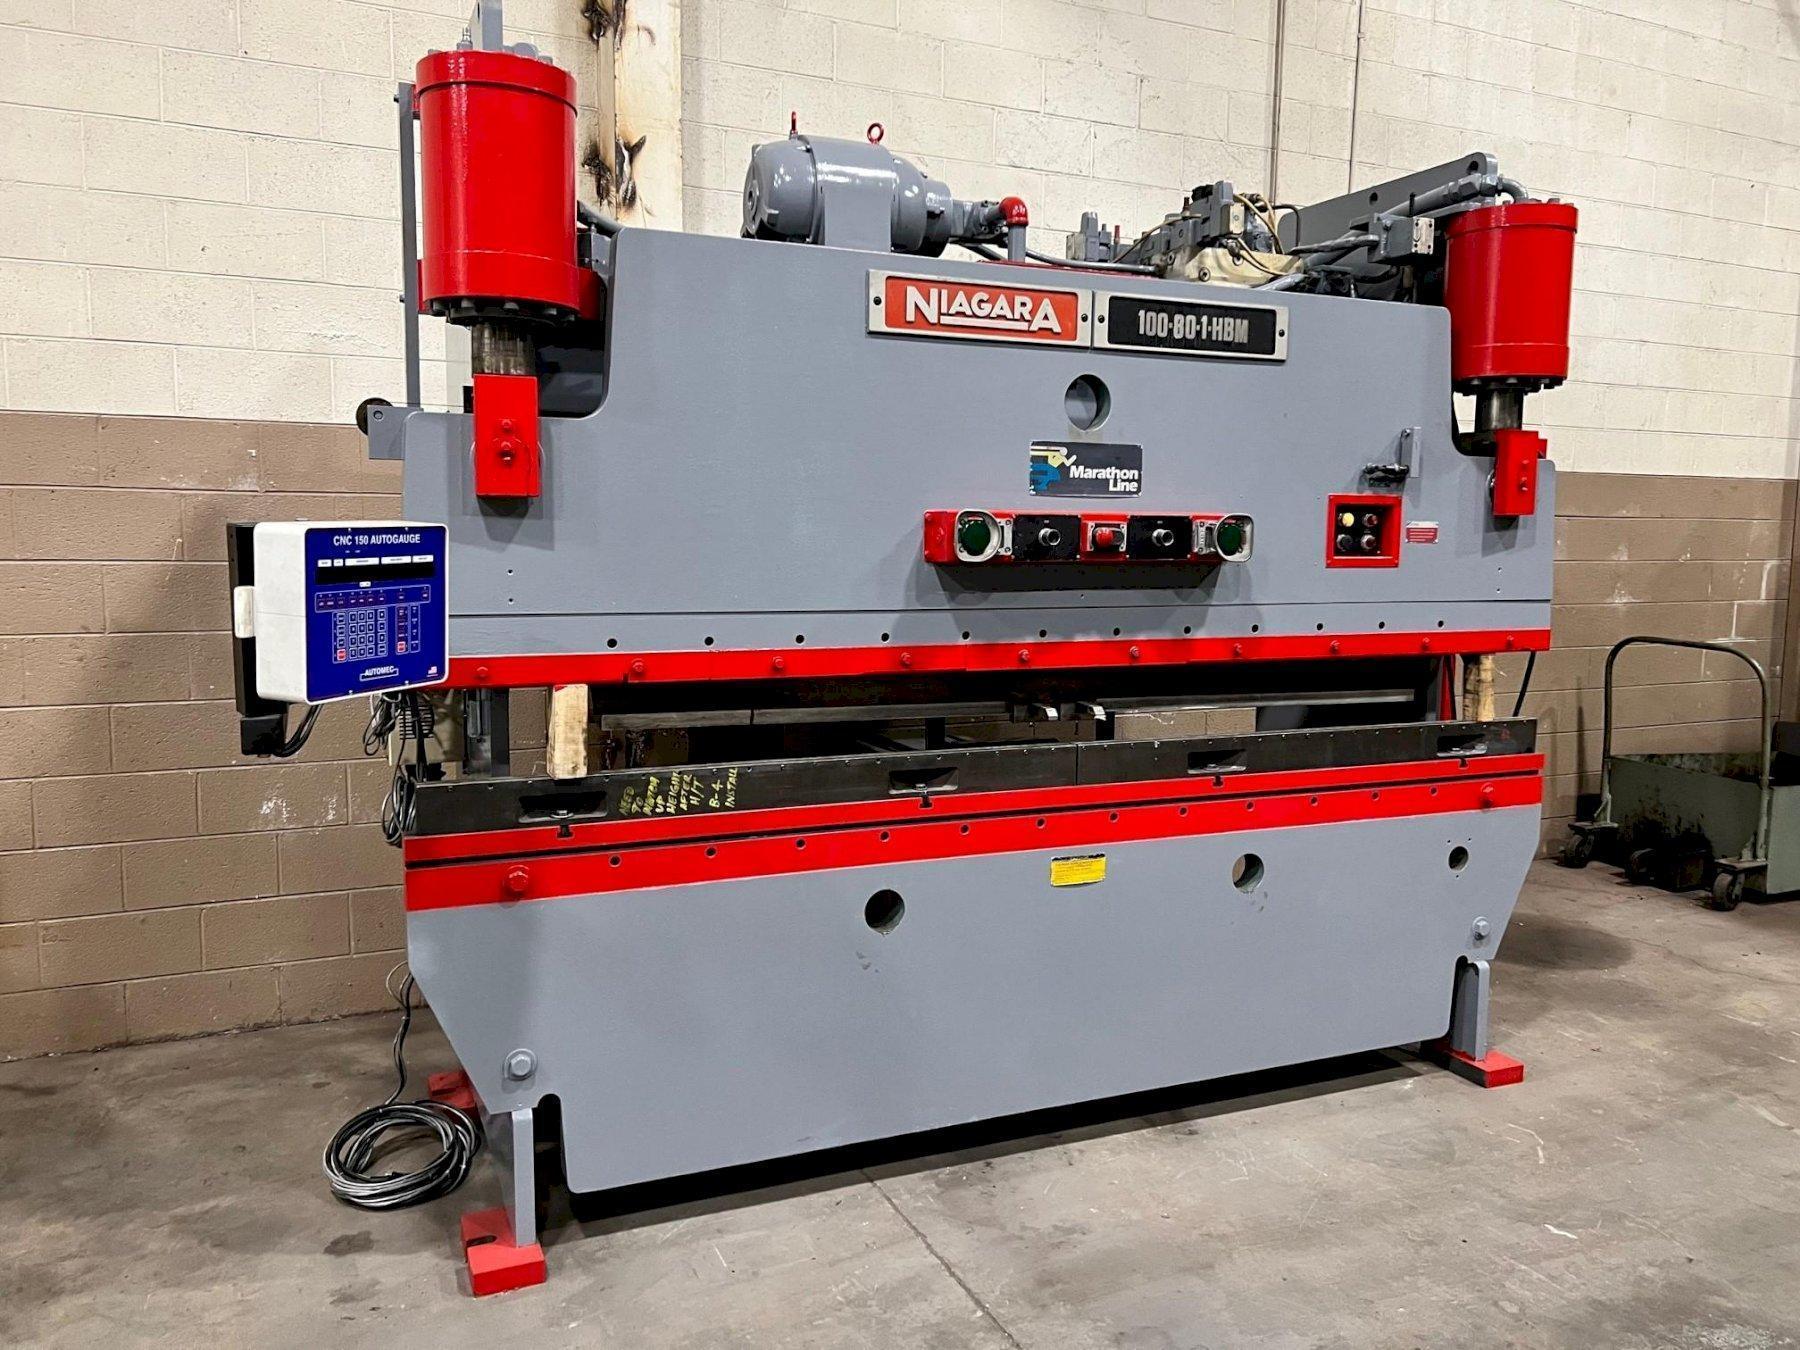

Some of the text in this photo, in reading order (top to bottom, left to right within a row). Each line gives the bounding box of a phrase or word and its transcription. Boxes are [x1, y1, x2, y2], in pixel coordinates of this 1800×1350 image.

[905, 285, 1062, 334] NIAGARA
[1069, 465, 1139, 479] Marathon
[1109, 479, 1138, 492] Line
[333, 534, 421, 546] CNC 150 AUTOGAUGE
[364, 665, 395, 677] AUTOMEC
[680, 774, 693, 811] AFTER
[690, 777, 705, 806] H/T
[725, 767, 738, 808] INSTALL
[655, 795, 666, 813] UP
